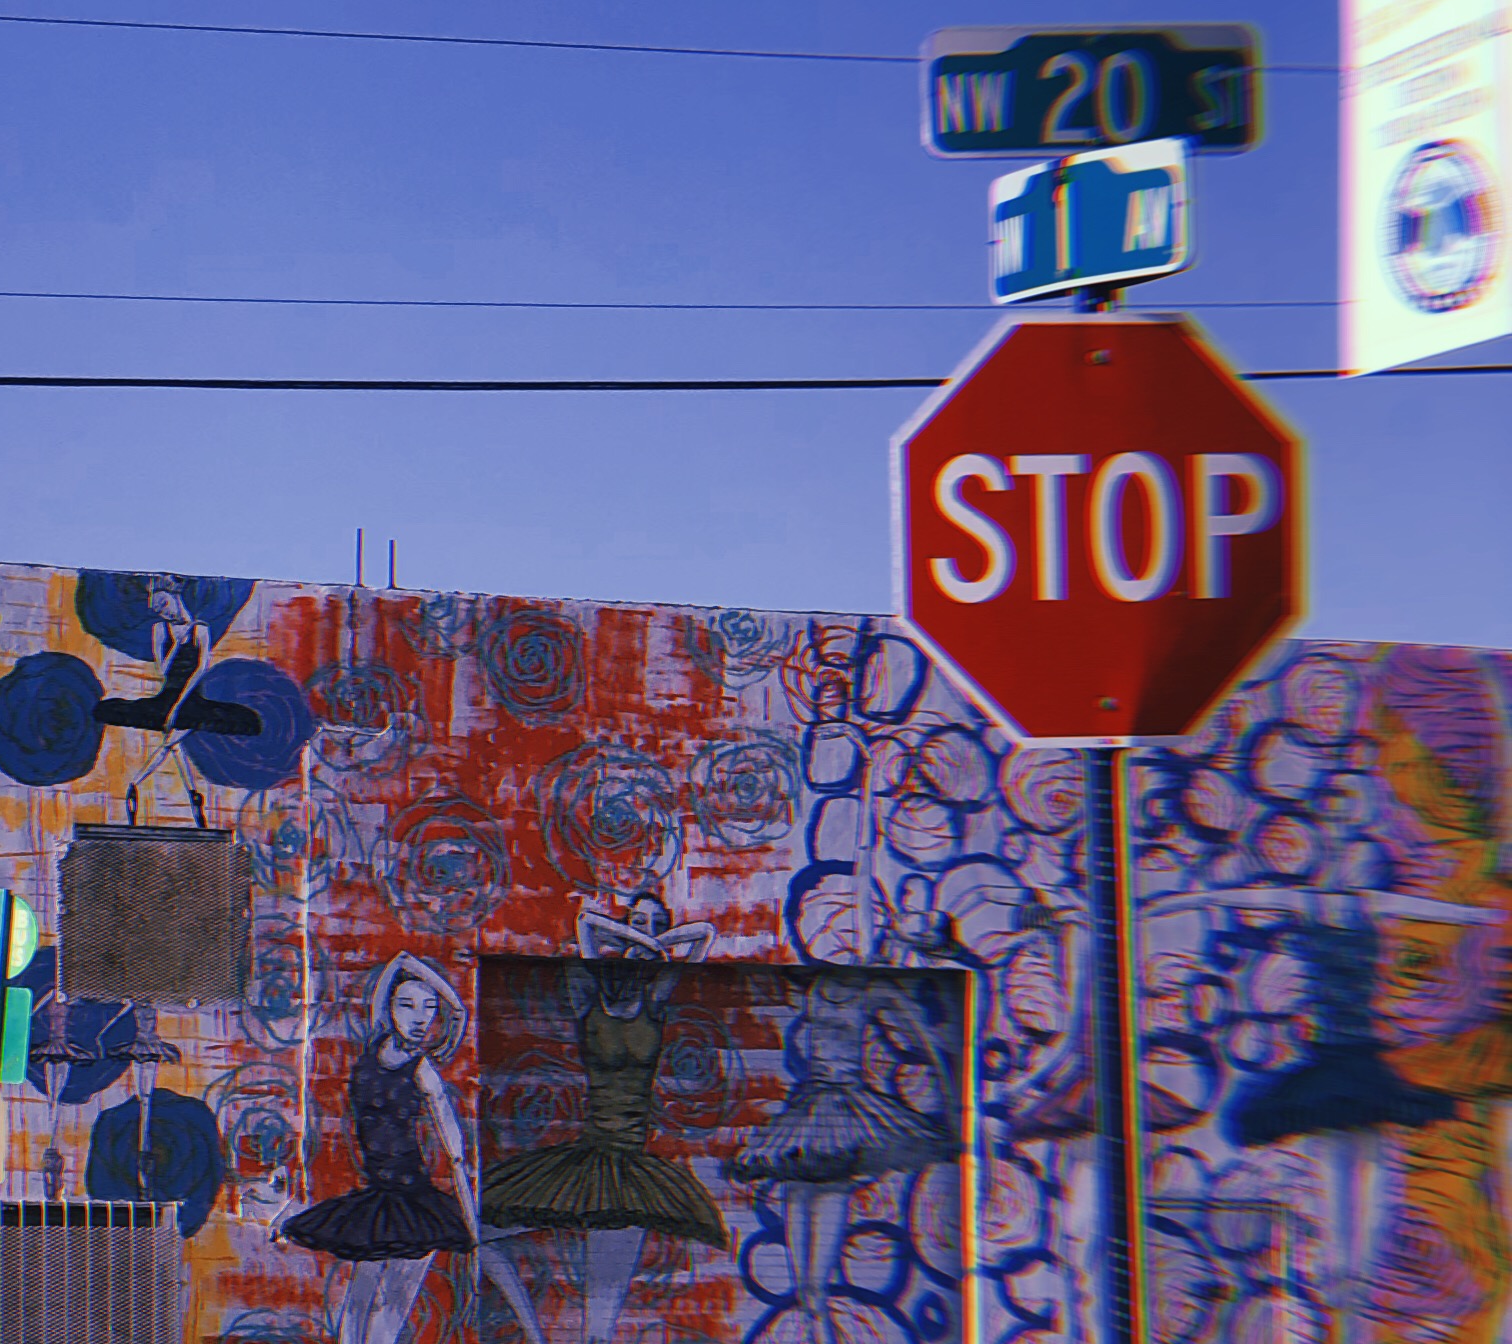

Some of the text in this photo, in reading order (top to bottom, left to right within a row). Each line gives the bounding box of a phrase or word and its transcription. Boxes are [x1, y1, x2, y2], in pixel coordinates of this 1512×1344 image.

[936, 69, 1014, 133] NW
[1037, 50, 1157, 142] 20
[1052, 181, 1074, 272] 1
[929, 452, 1284, 603] STOP
